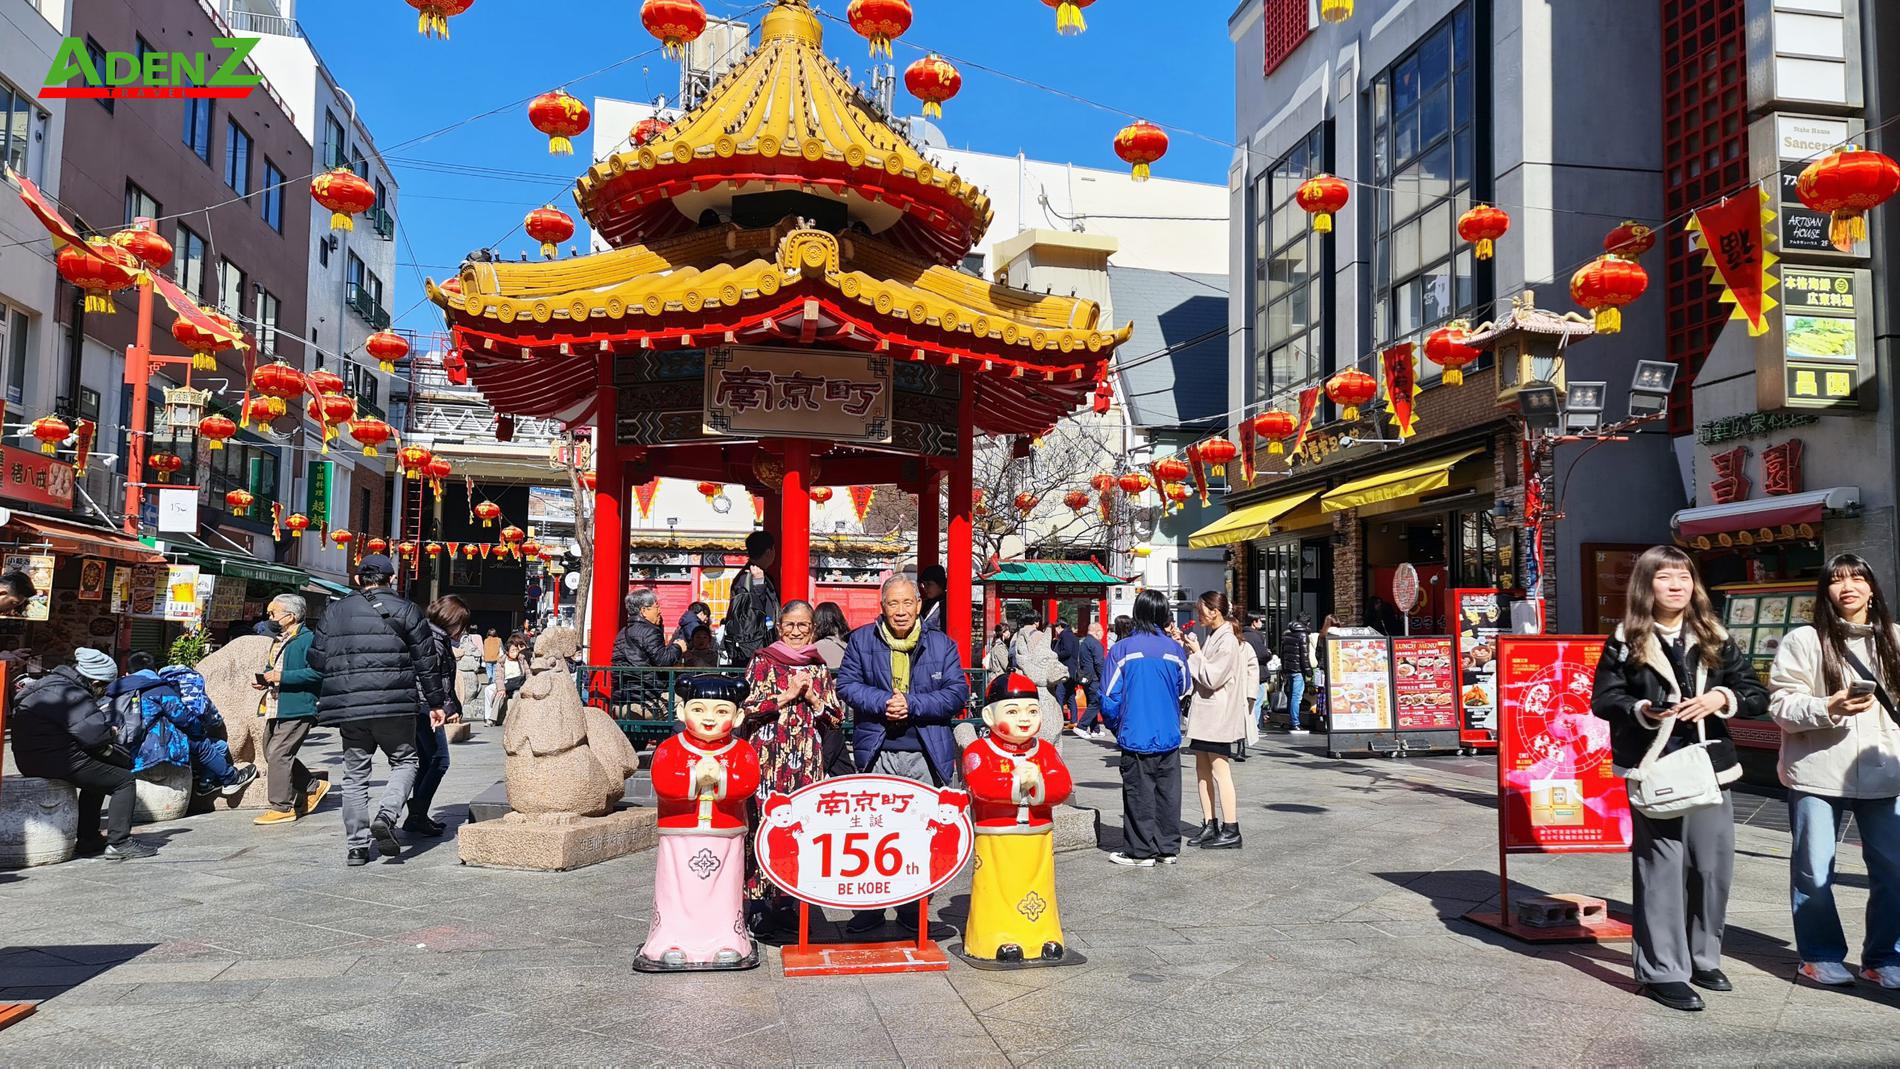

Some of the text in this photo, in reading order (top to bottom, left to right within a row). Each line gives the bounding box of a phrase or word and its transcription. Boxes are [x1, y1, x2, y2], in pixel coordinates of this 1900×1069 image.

[1788, 215, 1824, 228] ARTISAN
[1793, 227, 1821, 239] HOUSE
[714, 365, 884, 417] 南京町
[1395, 643, 1417, 651] LUNCH
[1418, 642, 1437, 650] MENU
[816, 790, 914, 816] 南京町
[849, 814, 885, 829] 生誕
[812, 831, 920, 878] 156 th
[837, 881, 892, 896] BE KOBE
